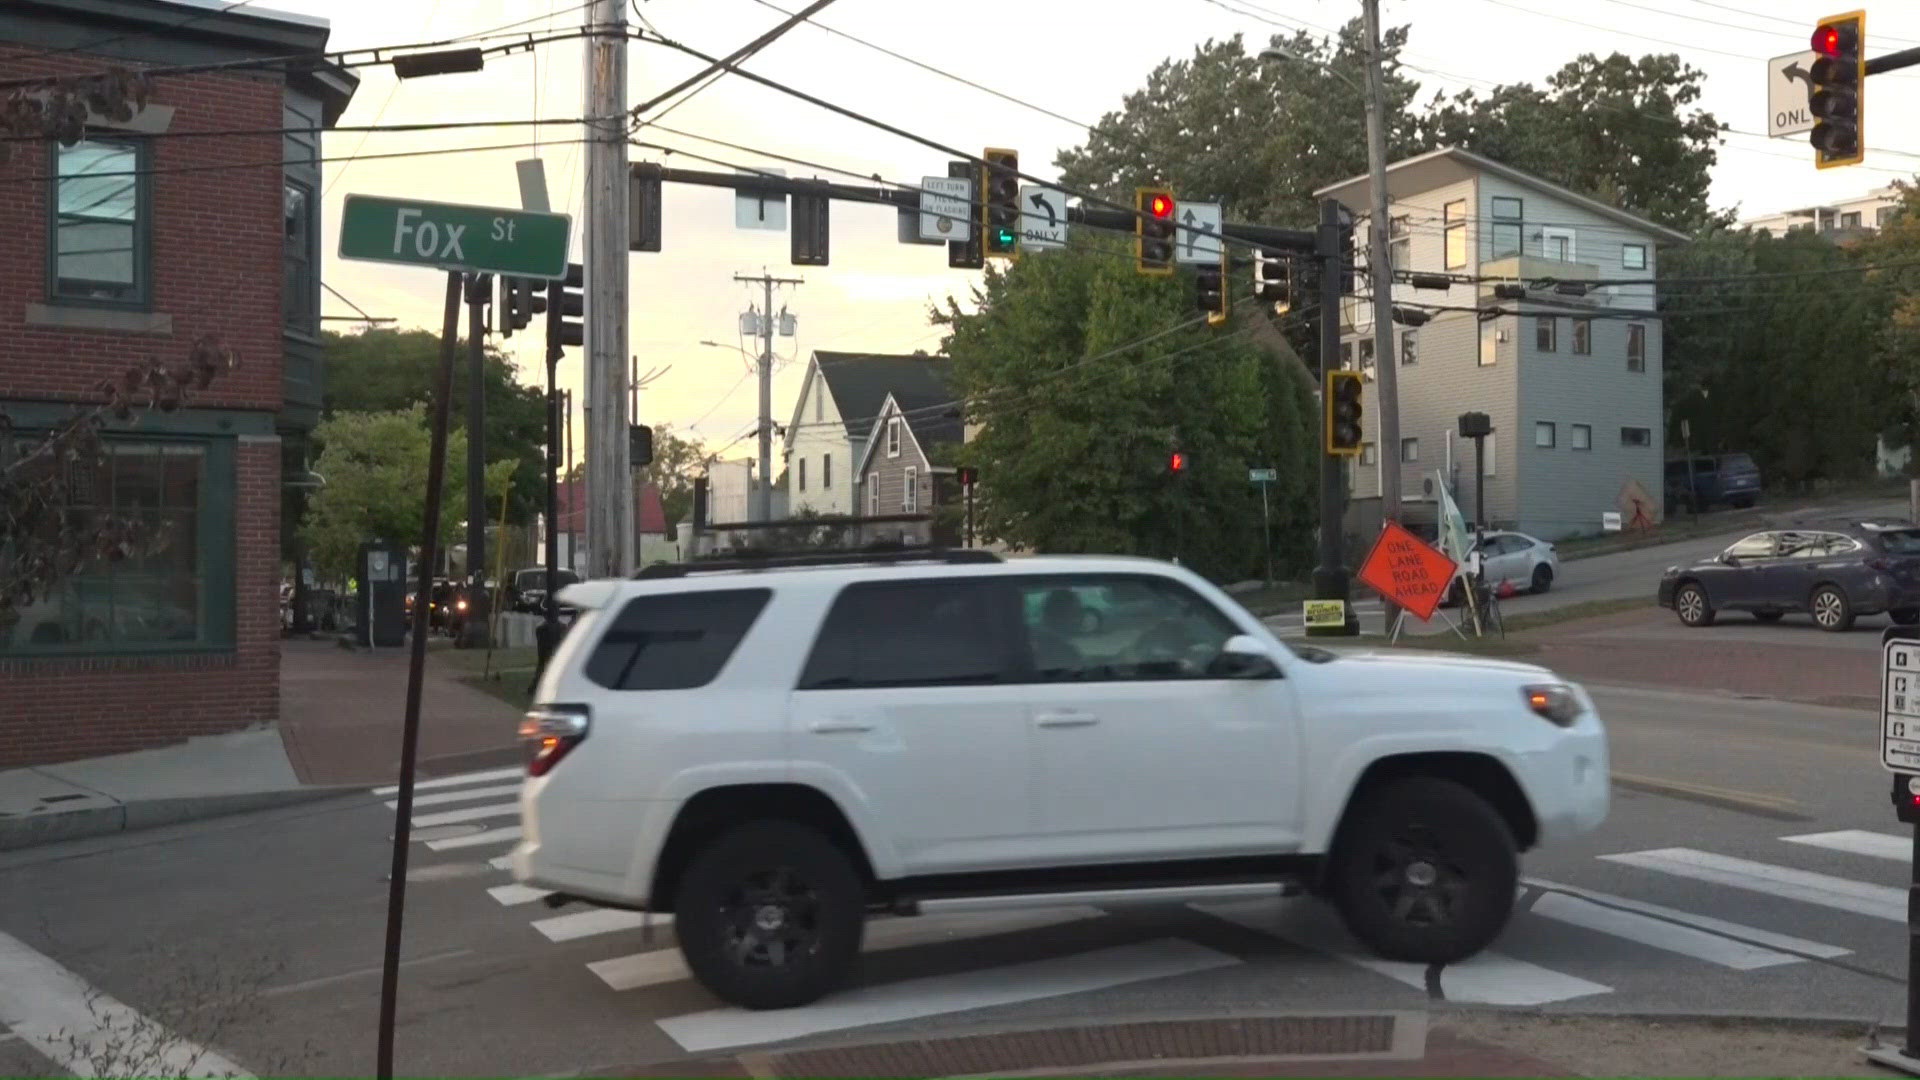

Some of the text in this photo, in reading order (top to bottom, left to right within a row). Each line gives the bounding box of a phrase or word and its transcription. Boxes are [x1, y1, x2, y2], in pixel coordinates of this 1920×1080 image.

[1776, 109, 1810, 128] ONL
[927, 181, 965, 192] LEFT TURN
[491, 216, 516, 242] St
[1026, 229, 1059, 242] ONLY
[1387, 540, 1414, 553] ONE
[1388, 554, 1424, 569] LANE
[1392, 567, 1429, 583] ROAD
[1395, 582, 1438, 597] AHEAD
